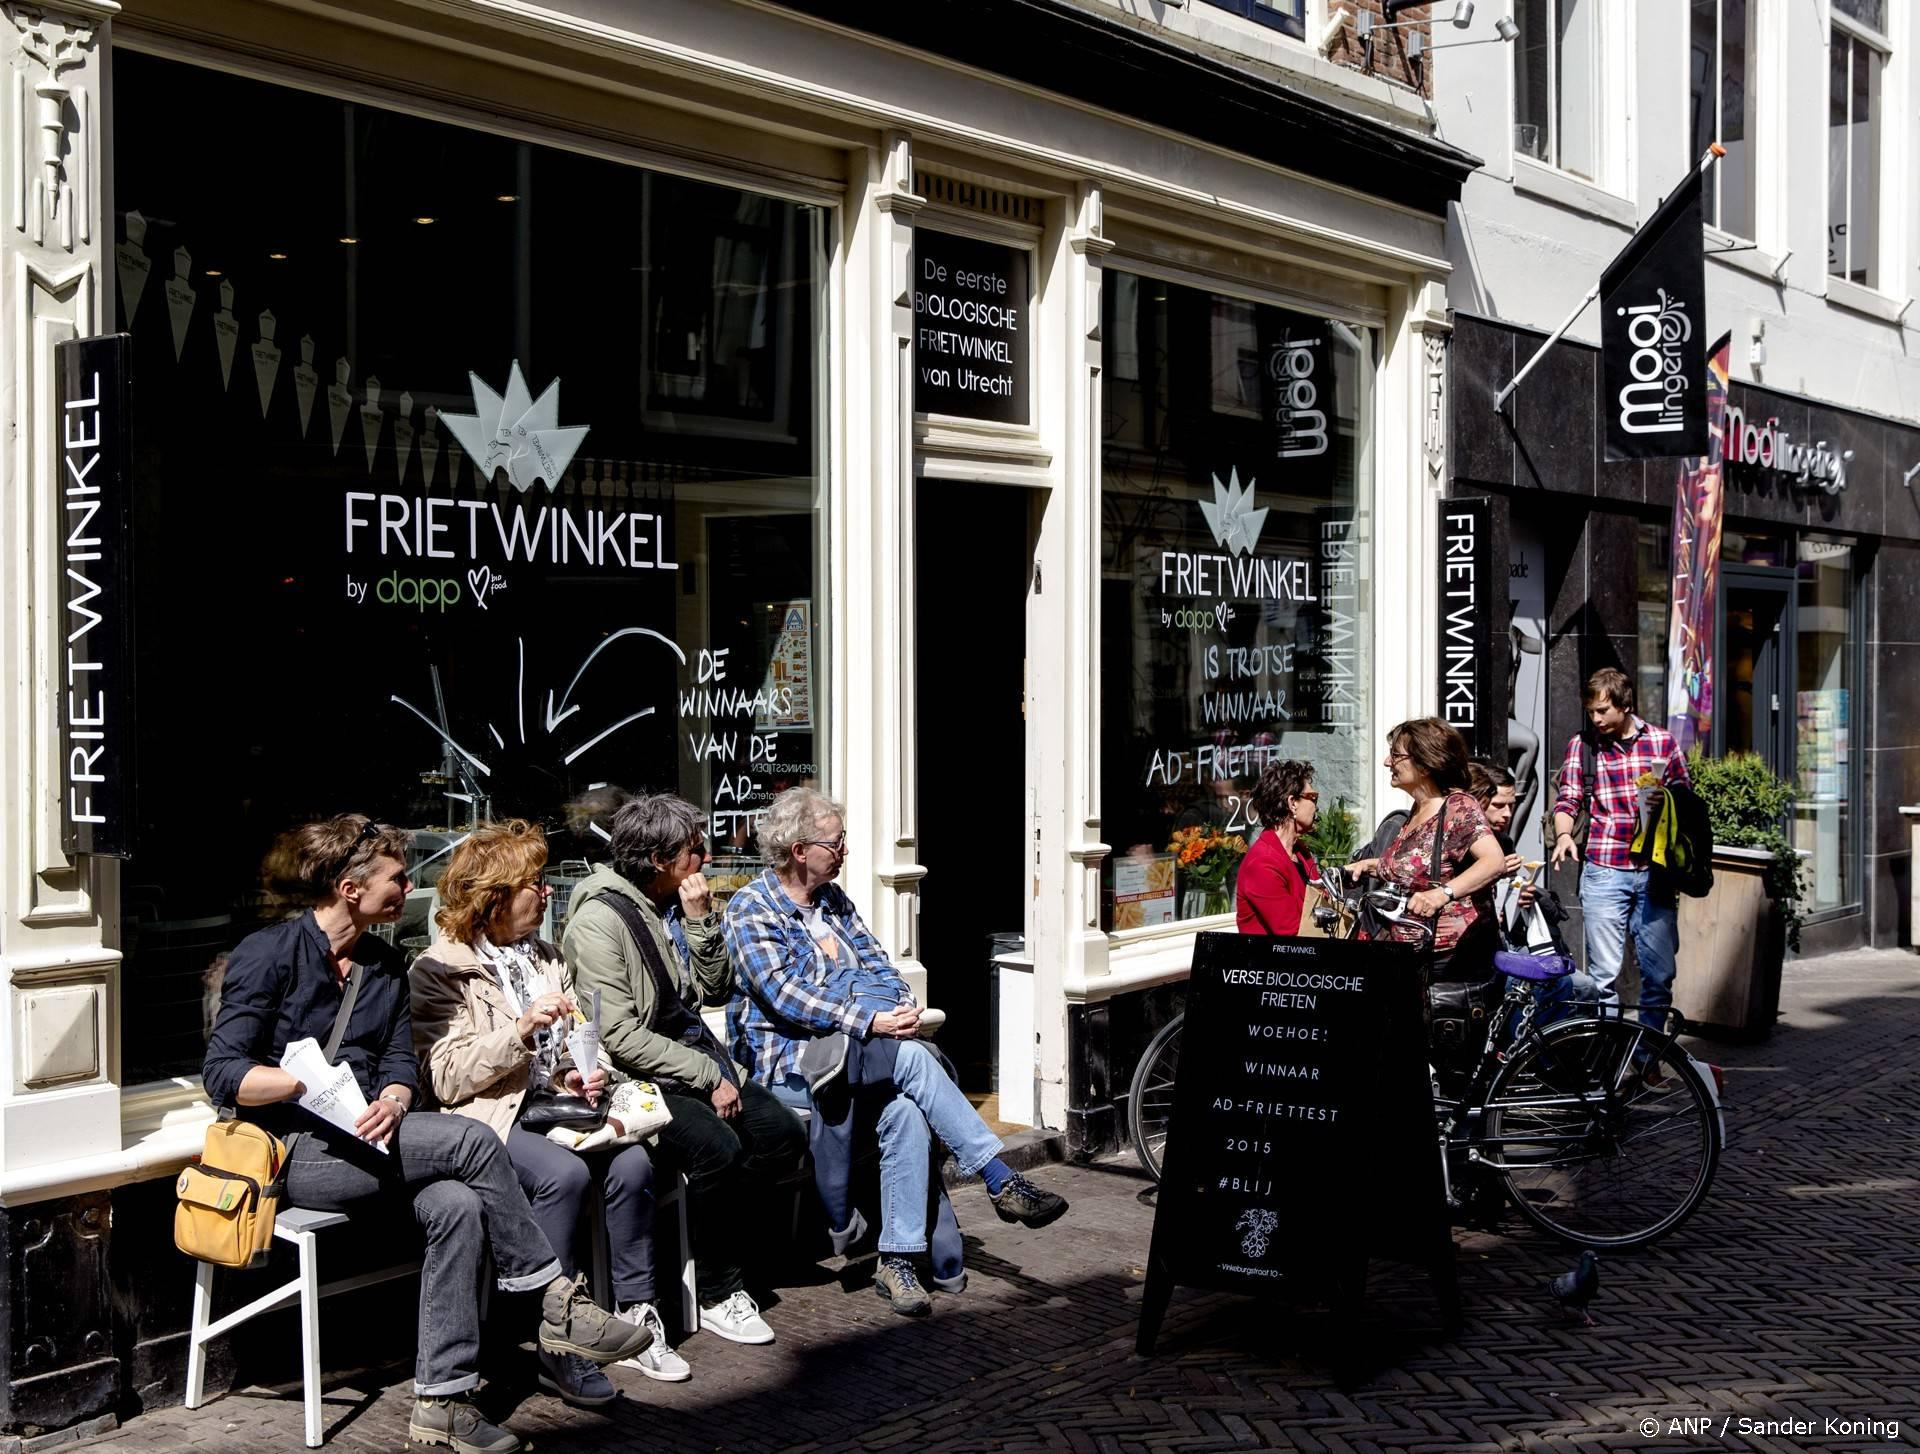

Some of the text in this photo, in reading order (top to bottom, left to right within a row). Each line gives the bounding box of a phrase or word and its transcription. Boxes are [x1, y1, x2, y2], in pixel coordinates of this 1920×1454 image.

[924, 258, 1007, 295] De eerste
[915, 291, 1017, 330] BIOLOGISCHE
[919, 327, 1014, 364] FRIETWINKEL
[921, 367, 1013, 396] van Utrecht
[1656, 314, 1690, 423] lingerie
[346, 491, 679, 570] FRIETWINKEL
[347, 574, 367, 604] by
[376, 570, 461, 613] dapp
[491, 580, 508, 595] food
[1161, 551, 1317, 601] FRIETWINKEL
[65, 371, 106, 824] FRIETWINKEL
[1161, 608, 1172, 628] by
[1175, 605, 1214, 635] dapp
[698, 648, 729, 684] DE
[1204, 645, 1218, 680] IS
[1226, 643, 1296, 681] TROTSE
[680, 686, 792, 719] WINNAARS
[1203, 689, 1291, 723] WINNAAR
[689, 731, 778, 763] VAN DE
[714, 773, 762, 805] AD-
[1272, 944, 1317, 955] FRIETWINKEL
[1222, 969, 1365, 992] VERSE BIOLOGISCHE
[1260, 991, 1317, 1010] FRIETEN
[1245, 1061, 1320, 1081] WINNAAR
[309, 1072, 353, 1110] FRIETWINKEL
[1226, 1138, 1272, 1154] 2015
[1218, 1176, 1273, 1196] #BLIJ
